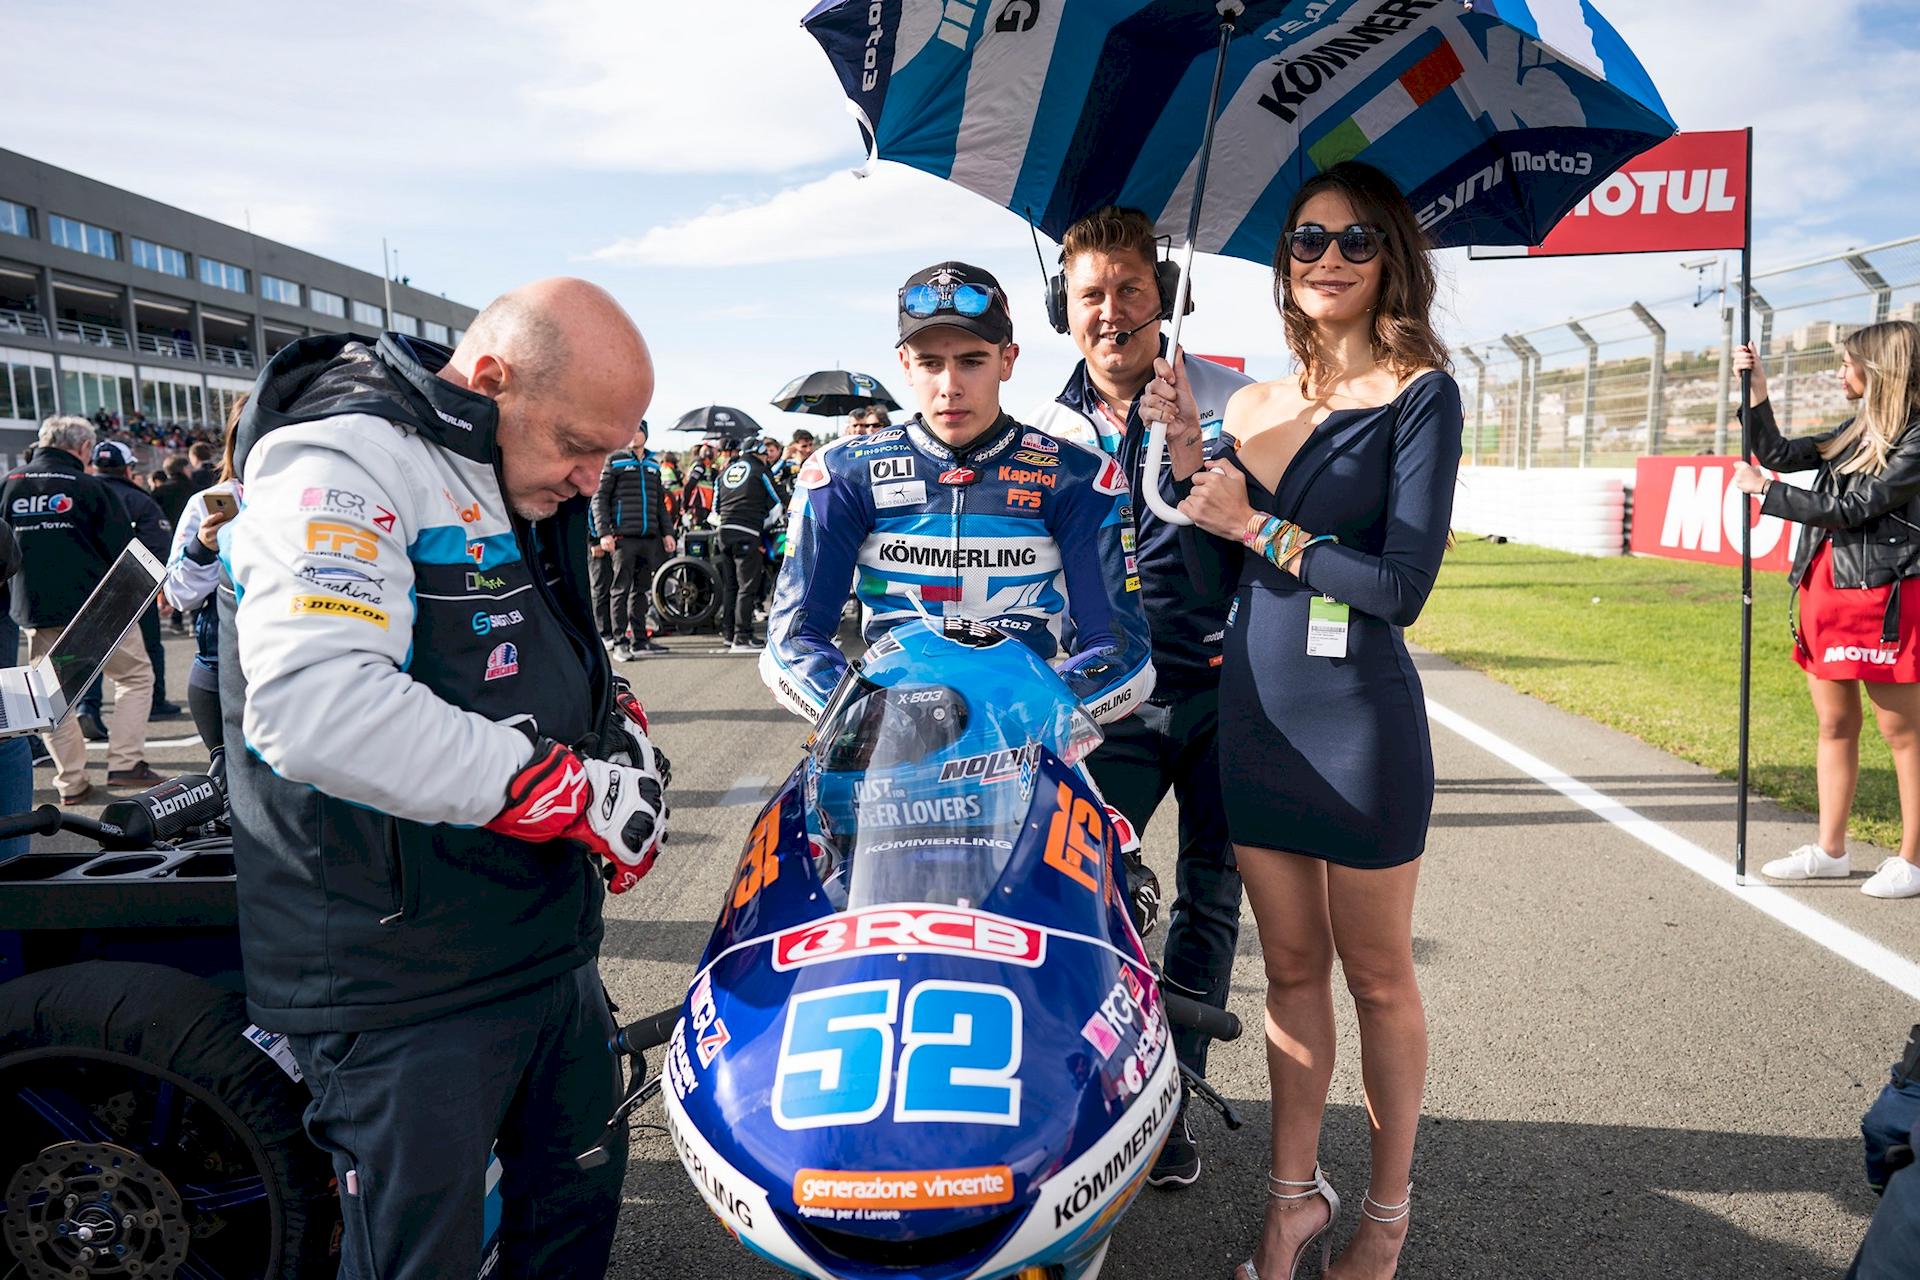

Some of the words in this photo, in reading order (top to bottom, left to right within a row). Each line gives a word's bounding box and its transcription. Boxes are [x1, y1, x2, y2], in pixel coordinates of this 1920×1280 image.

[862, 0, 883, 92] oto3
[1257, 0, 1443, 124] KÖMMER
[998, 465, 1057, 488] Kapriol
[12, 495, 49, 513] elf
[326, 489, 366, 513] FGR
[1007, 488, 1042, 508] FPS
[307, 521, 379, 561] FPS
[879, 540, 1037, 568] KÖMMERLING
[308, 600, 385, 621] DUNLOP
[1824, 646, 1898, 665] MOTUL
[150, 782, 215, 819] domino
[853, 777, 893, 803] JUST
[902, 795, 981, 824] LOVERS
[771, 980, 1022, 1131] 52
[1054, 1066, 1179, 1229] KÖMMERLING
[802, 1177, 918, 1201] generazione
[924, 1174, 1004, 1198] vincente
[865, 1209, 900, 1221] Lavoro
